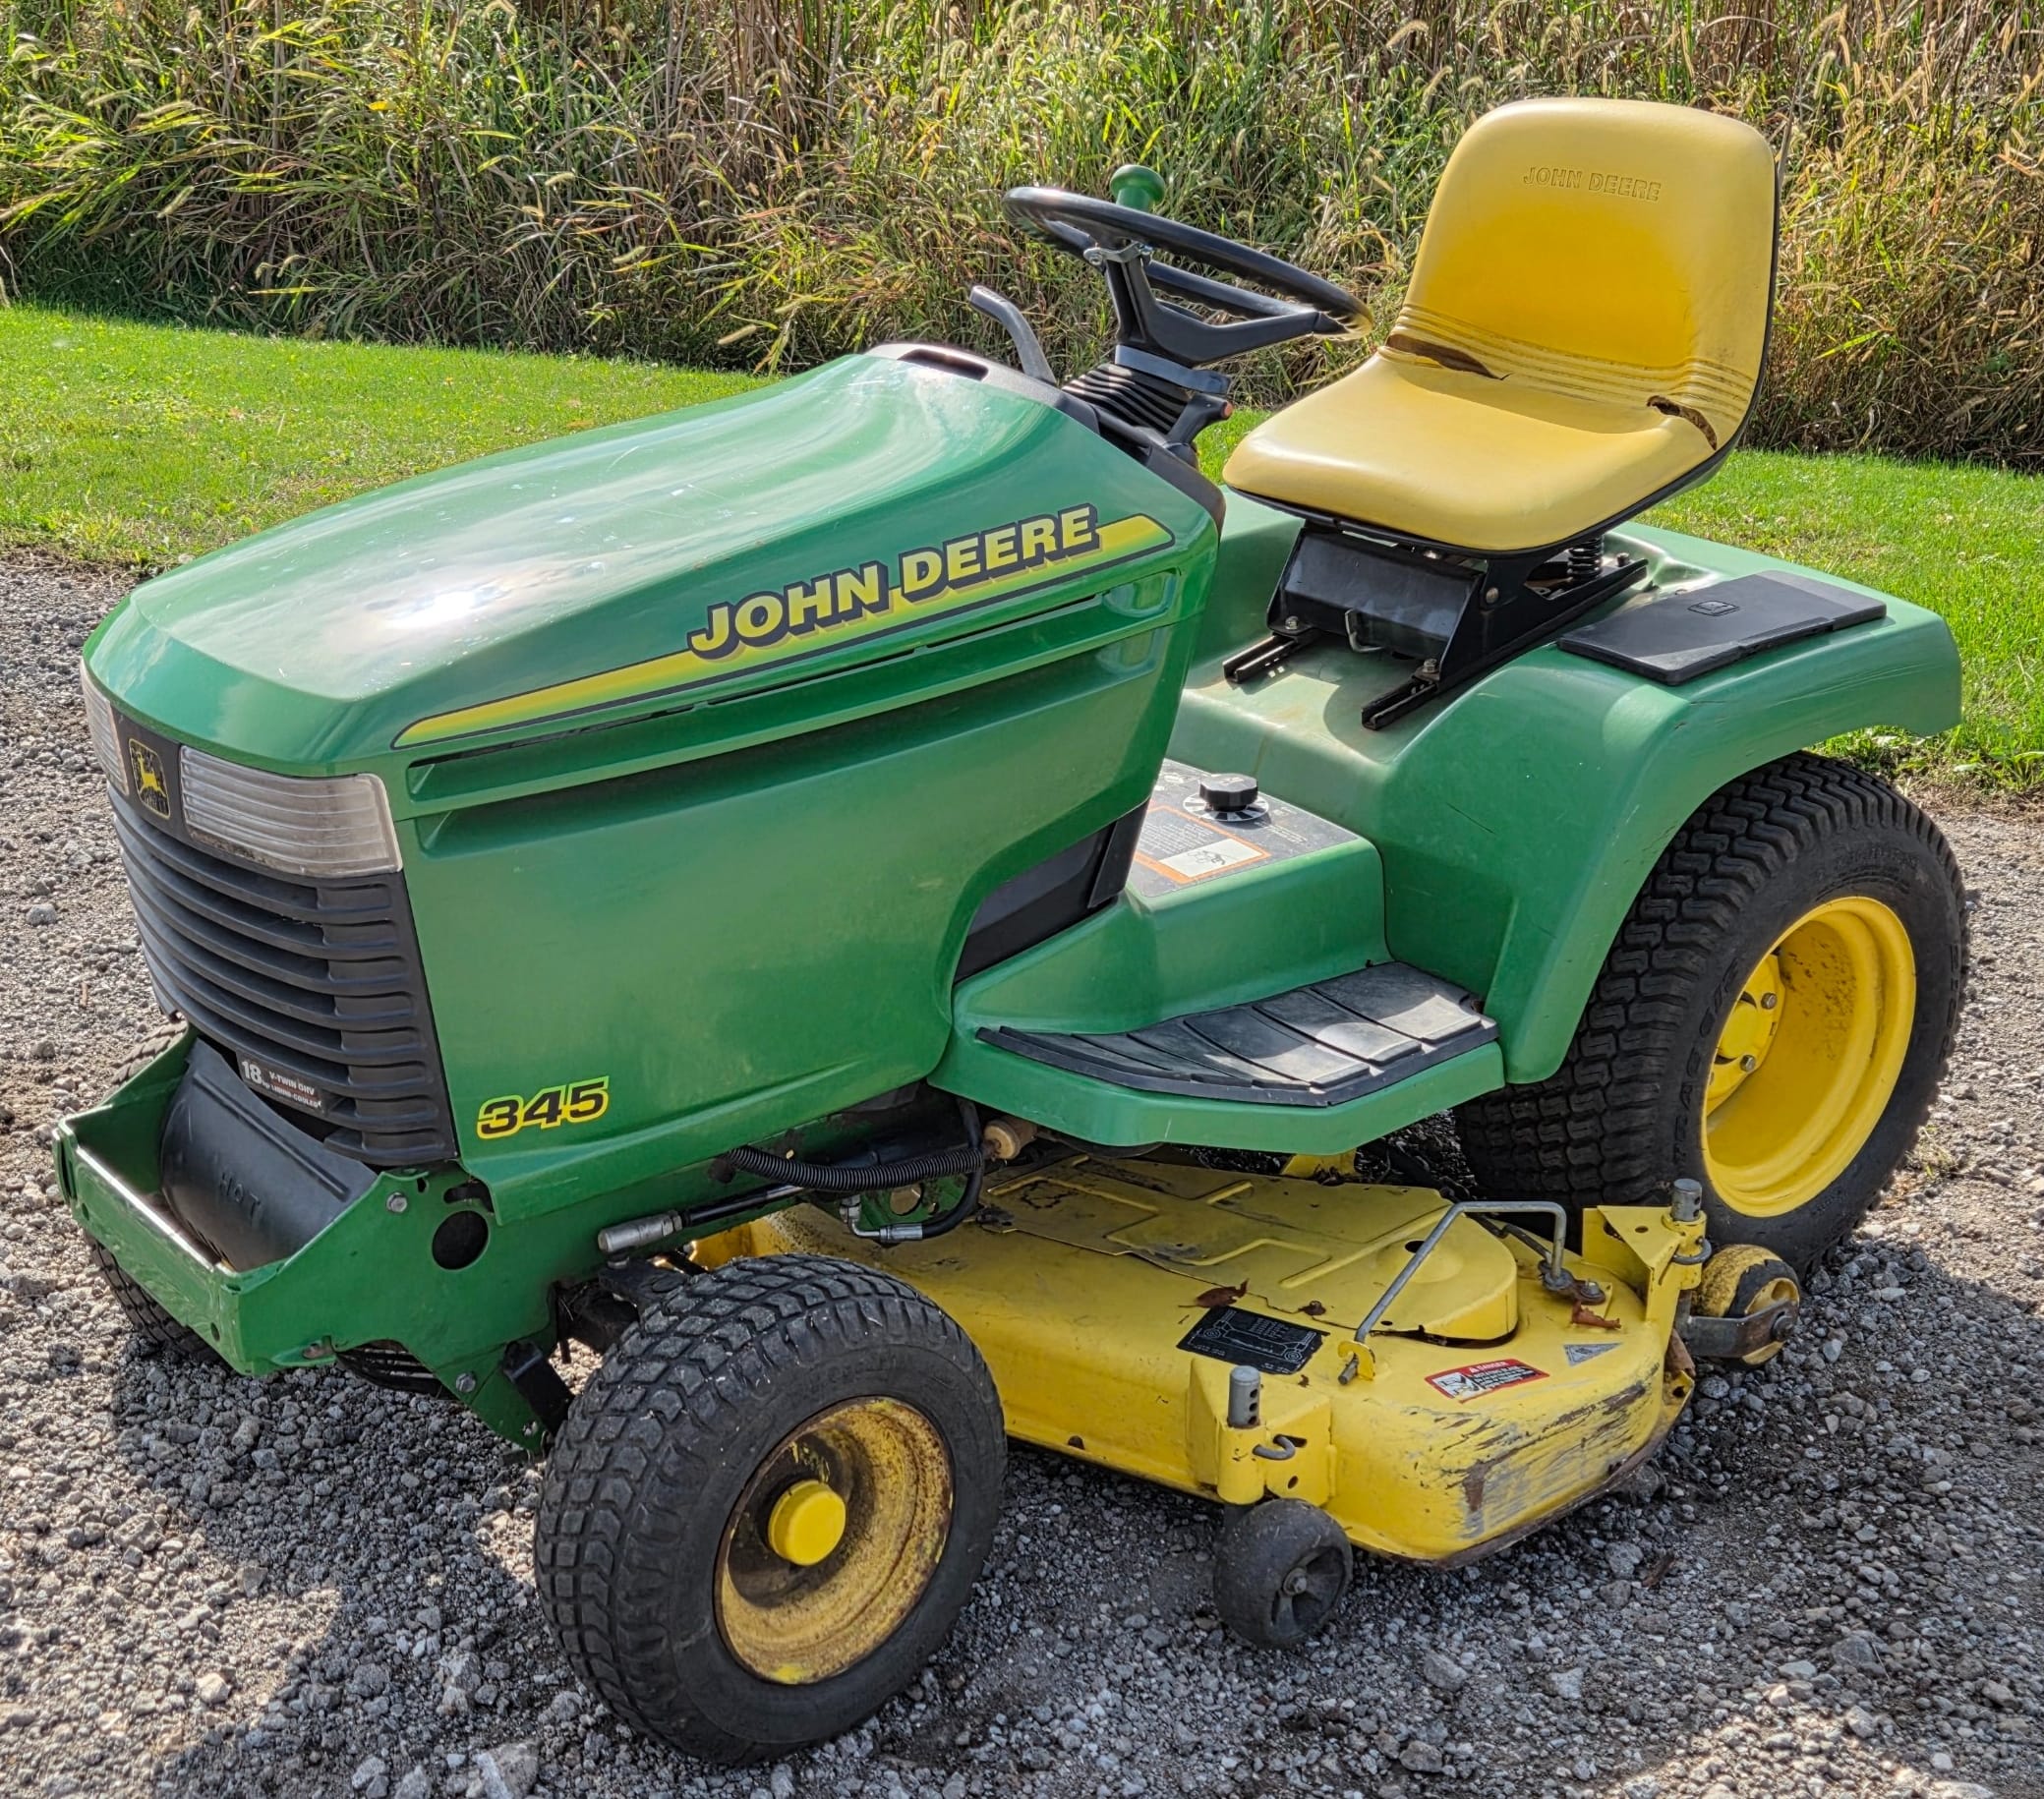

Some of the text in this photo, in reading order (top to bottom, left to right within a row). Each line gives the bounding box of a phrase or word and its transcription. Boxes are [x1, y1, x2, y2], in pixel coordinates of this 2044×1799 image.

[1523, 166, 1662, 202] JOHN DEERE
[688, 504, 1098, 656] JOHN DEERE
[242, 1061, 263, 1083] 18
[477, 1075, 609, 1139] 345
[219, 1170, 262, 1222] HOT
